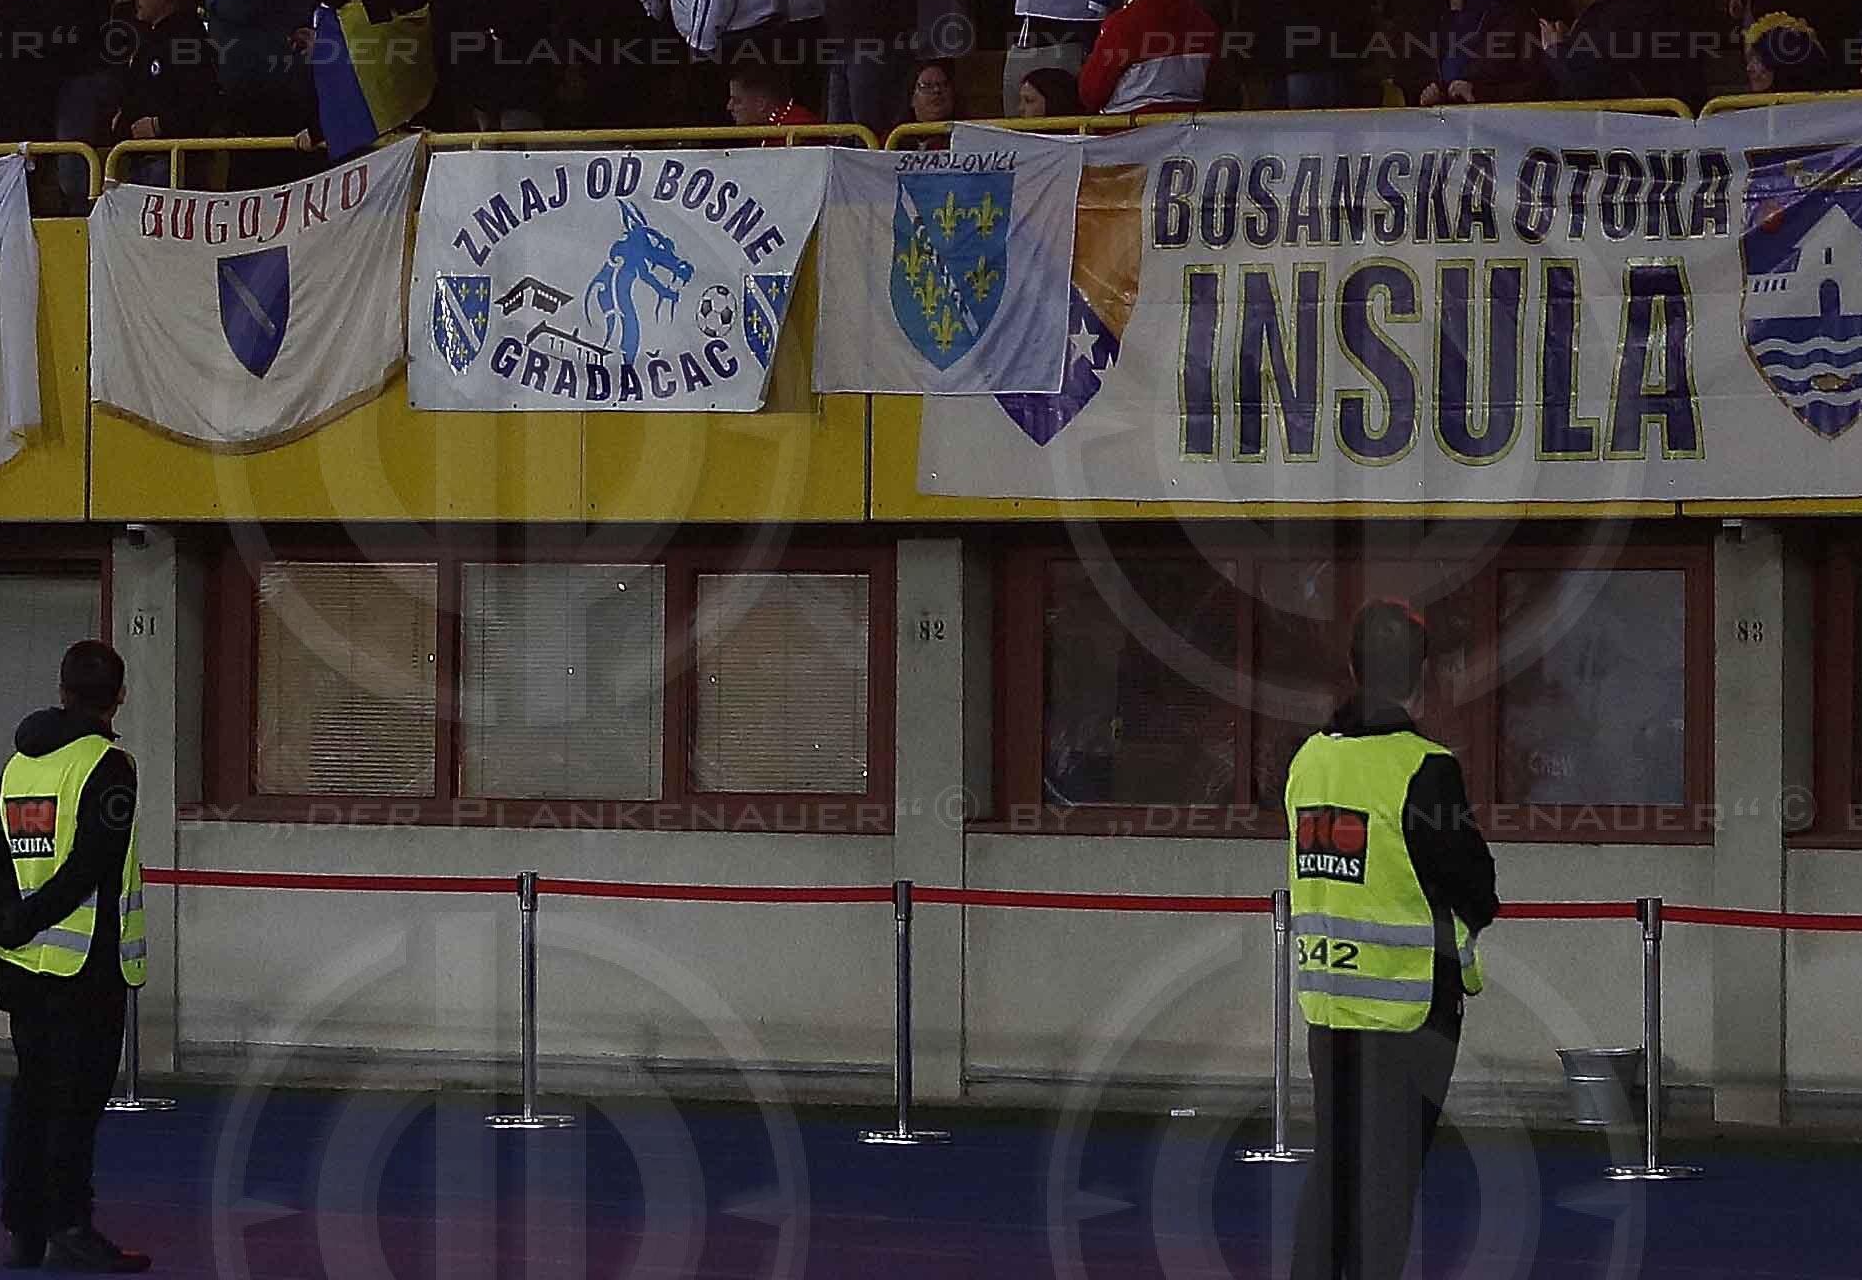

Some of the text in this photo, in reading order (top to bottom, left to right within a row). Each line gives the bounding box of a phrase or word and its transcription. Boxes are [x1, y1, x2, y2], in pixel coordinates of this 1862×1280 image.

[141, 164, 369, 245] BUGOJNO
[451, 154, 788, 268] ZMAJ OD BOSNE
[1152, 147, 1734, 250] BOSANSKA OTOKA
[1177, 256, 1707, 468] INSULA
